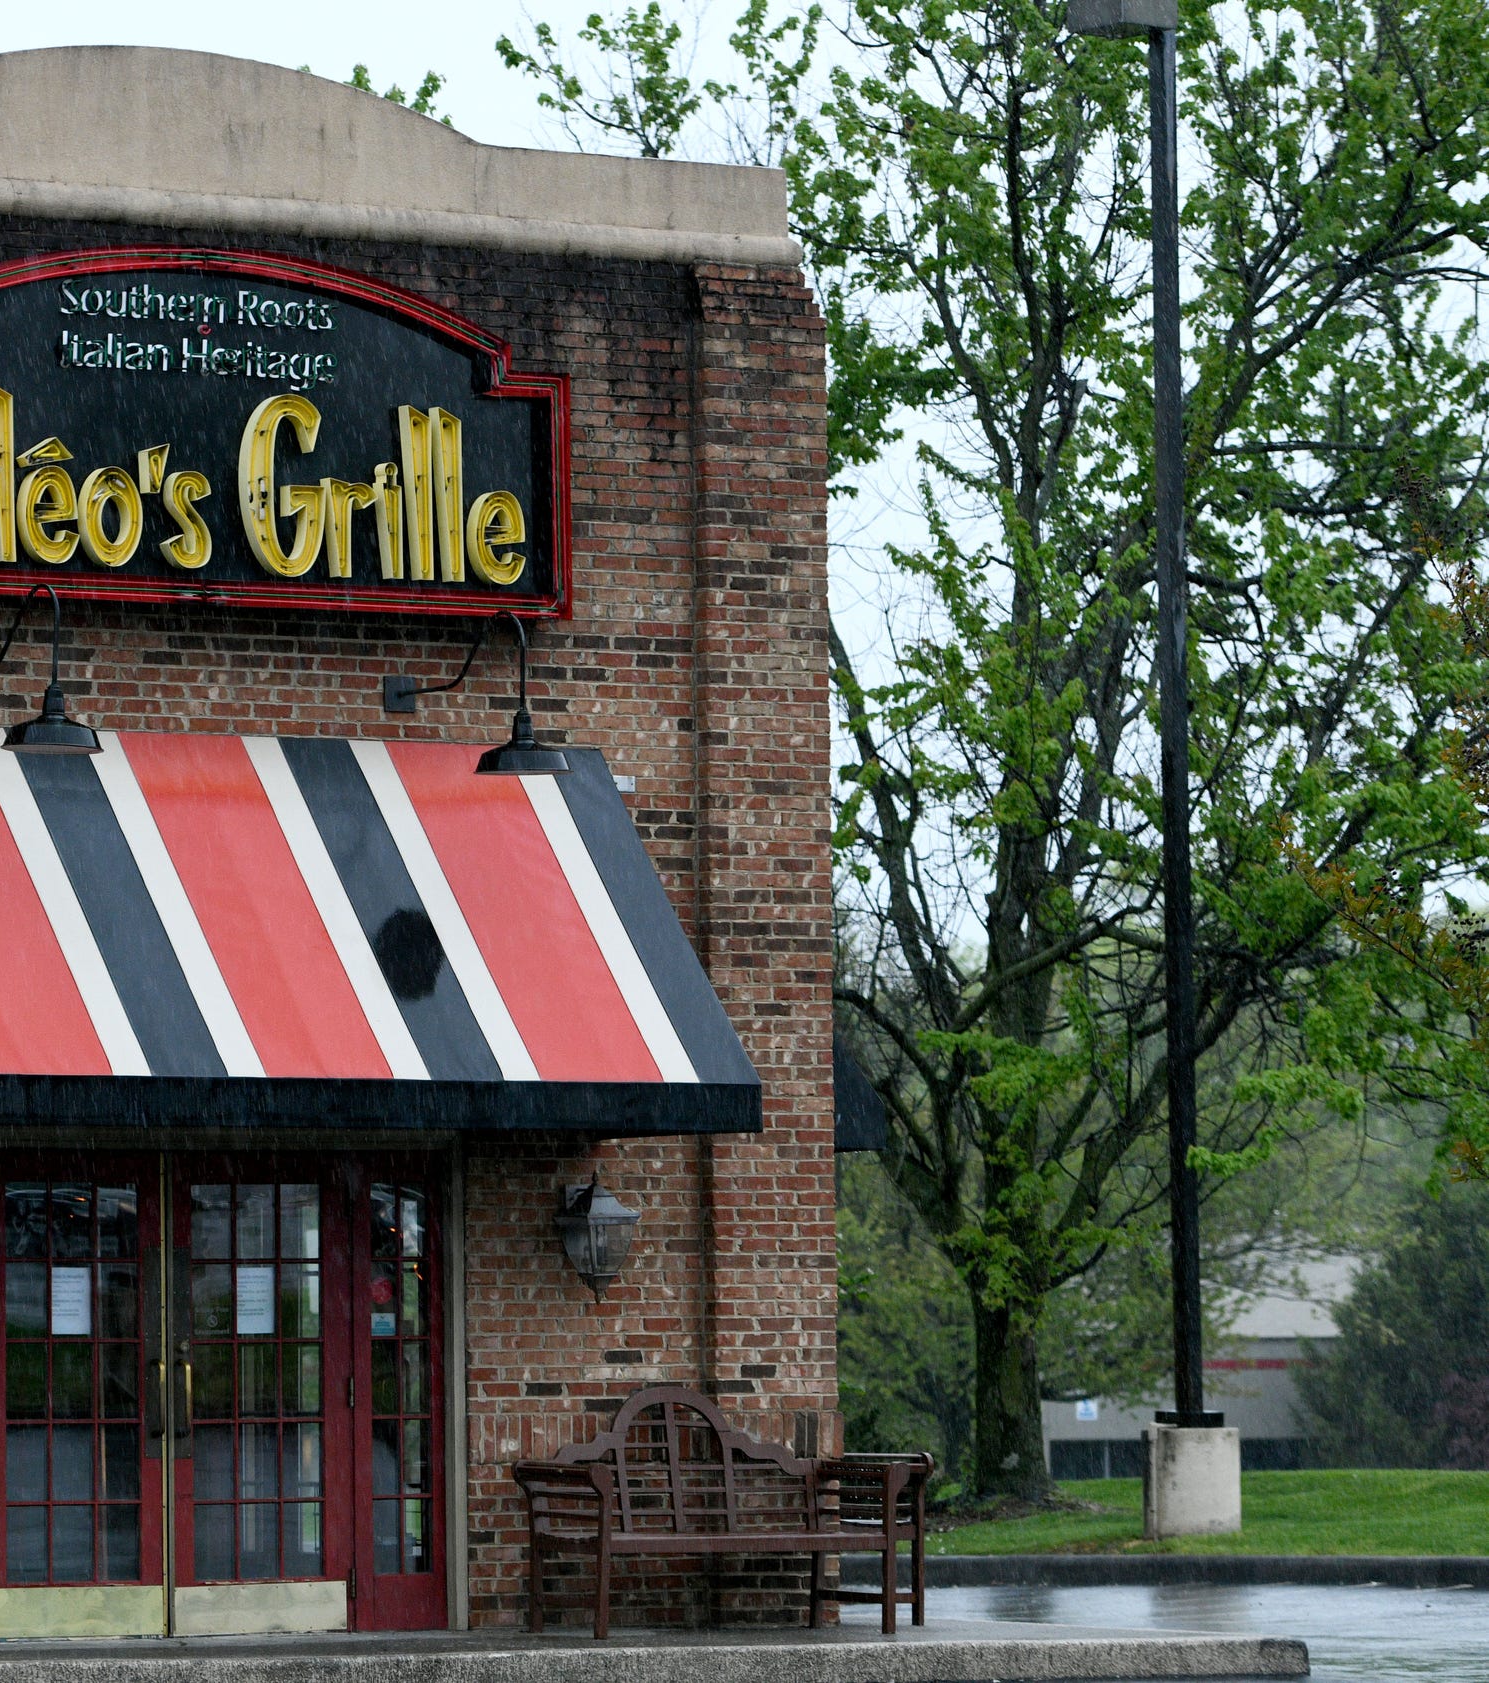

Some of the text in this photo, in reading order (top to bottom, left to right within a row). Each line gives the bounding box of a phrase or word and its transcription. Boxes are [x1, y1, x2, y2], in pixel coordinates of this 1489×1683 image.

[60, 279, 339, 331] Southern Roots
[61, 330, 337, 391] Italian Heritage
[238, 393, 527, 585] Grille
